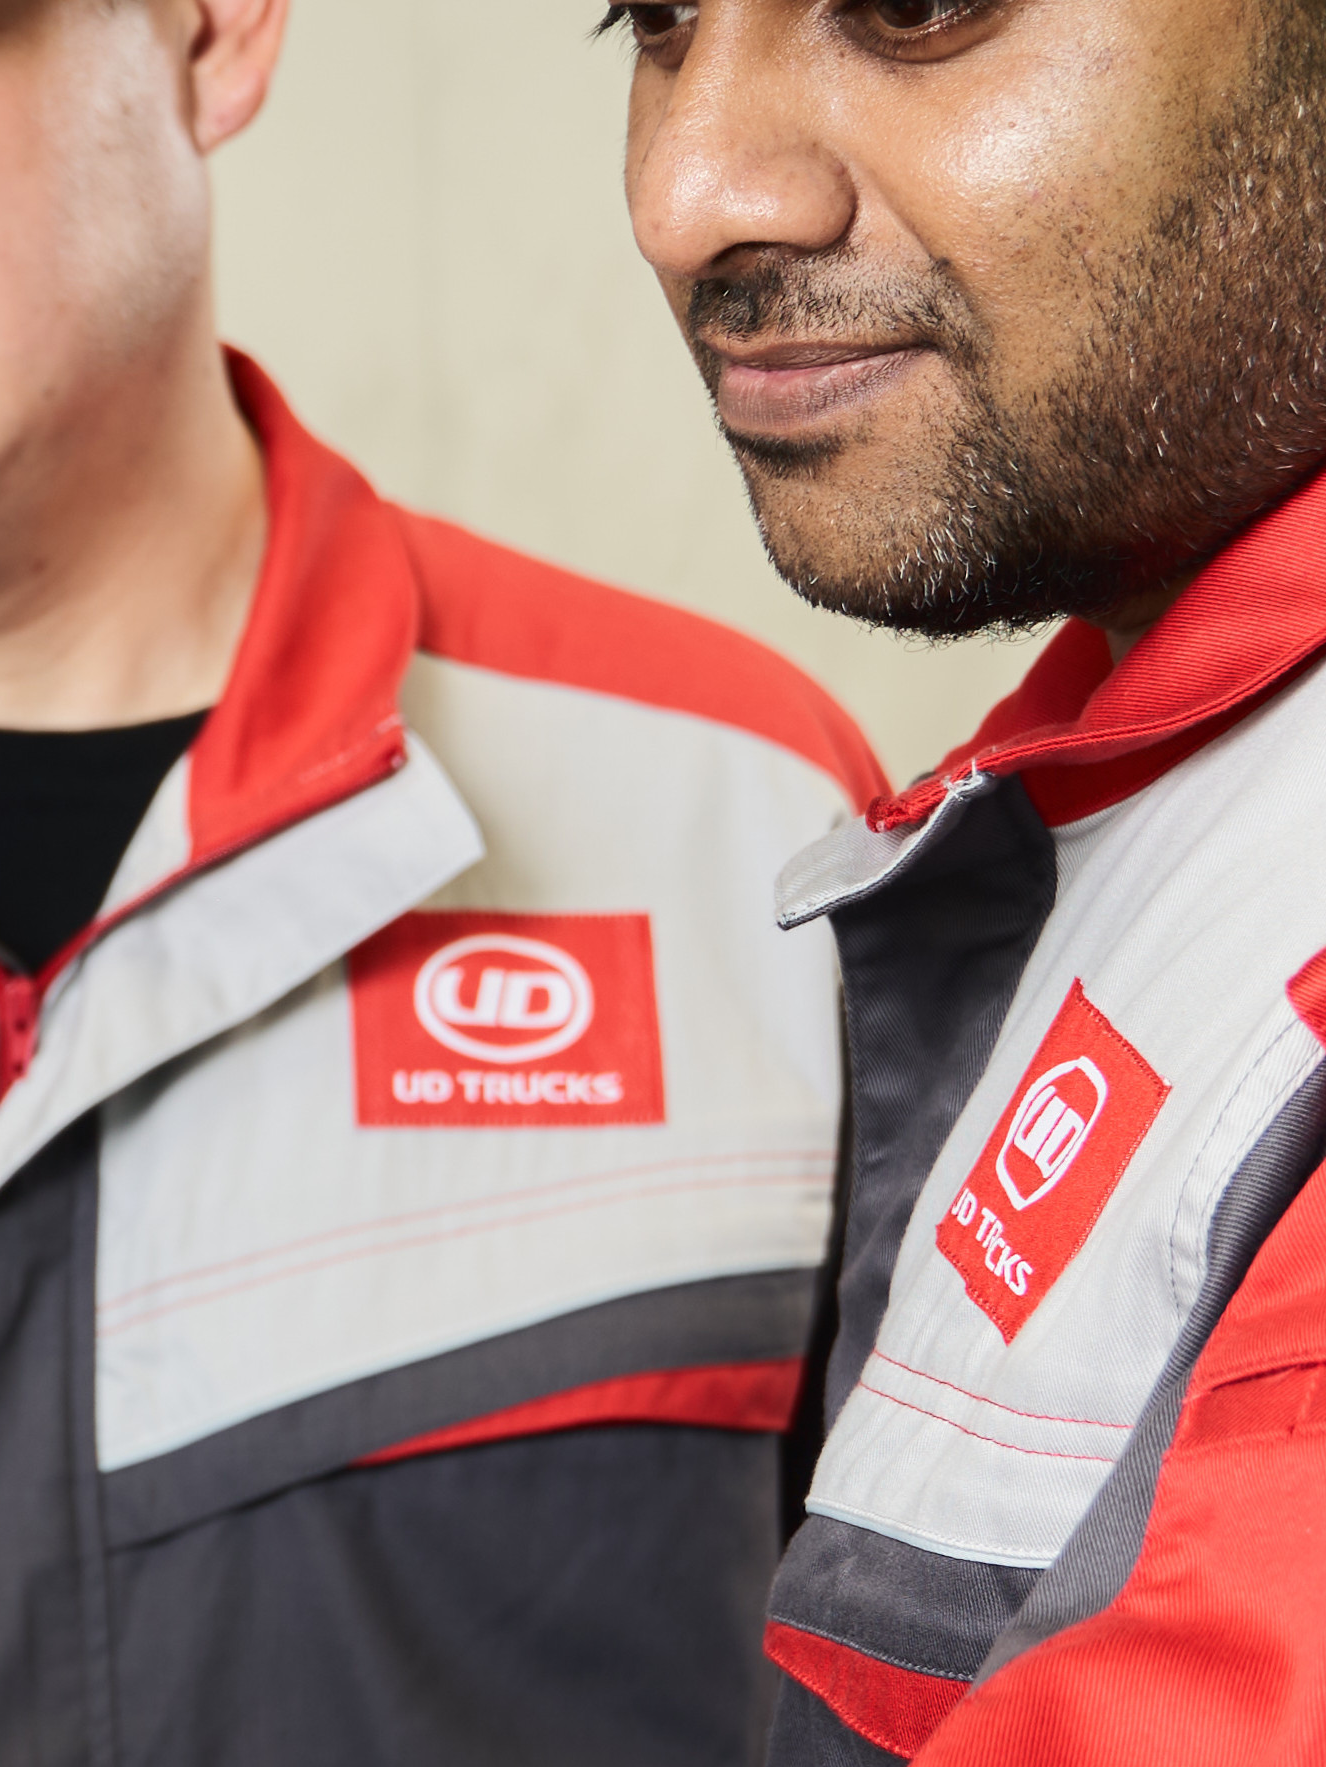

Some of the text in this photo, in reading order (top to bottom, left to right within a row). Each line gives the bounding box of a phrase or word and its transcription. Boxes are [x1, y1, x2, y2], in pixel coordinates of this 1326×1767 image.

[434, 967, 574, 1029] UD
[392, 1070, 624, 1105] UD TRUCKS
